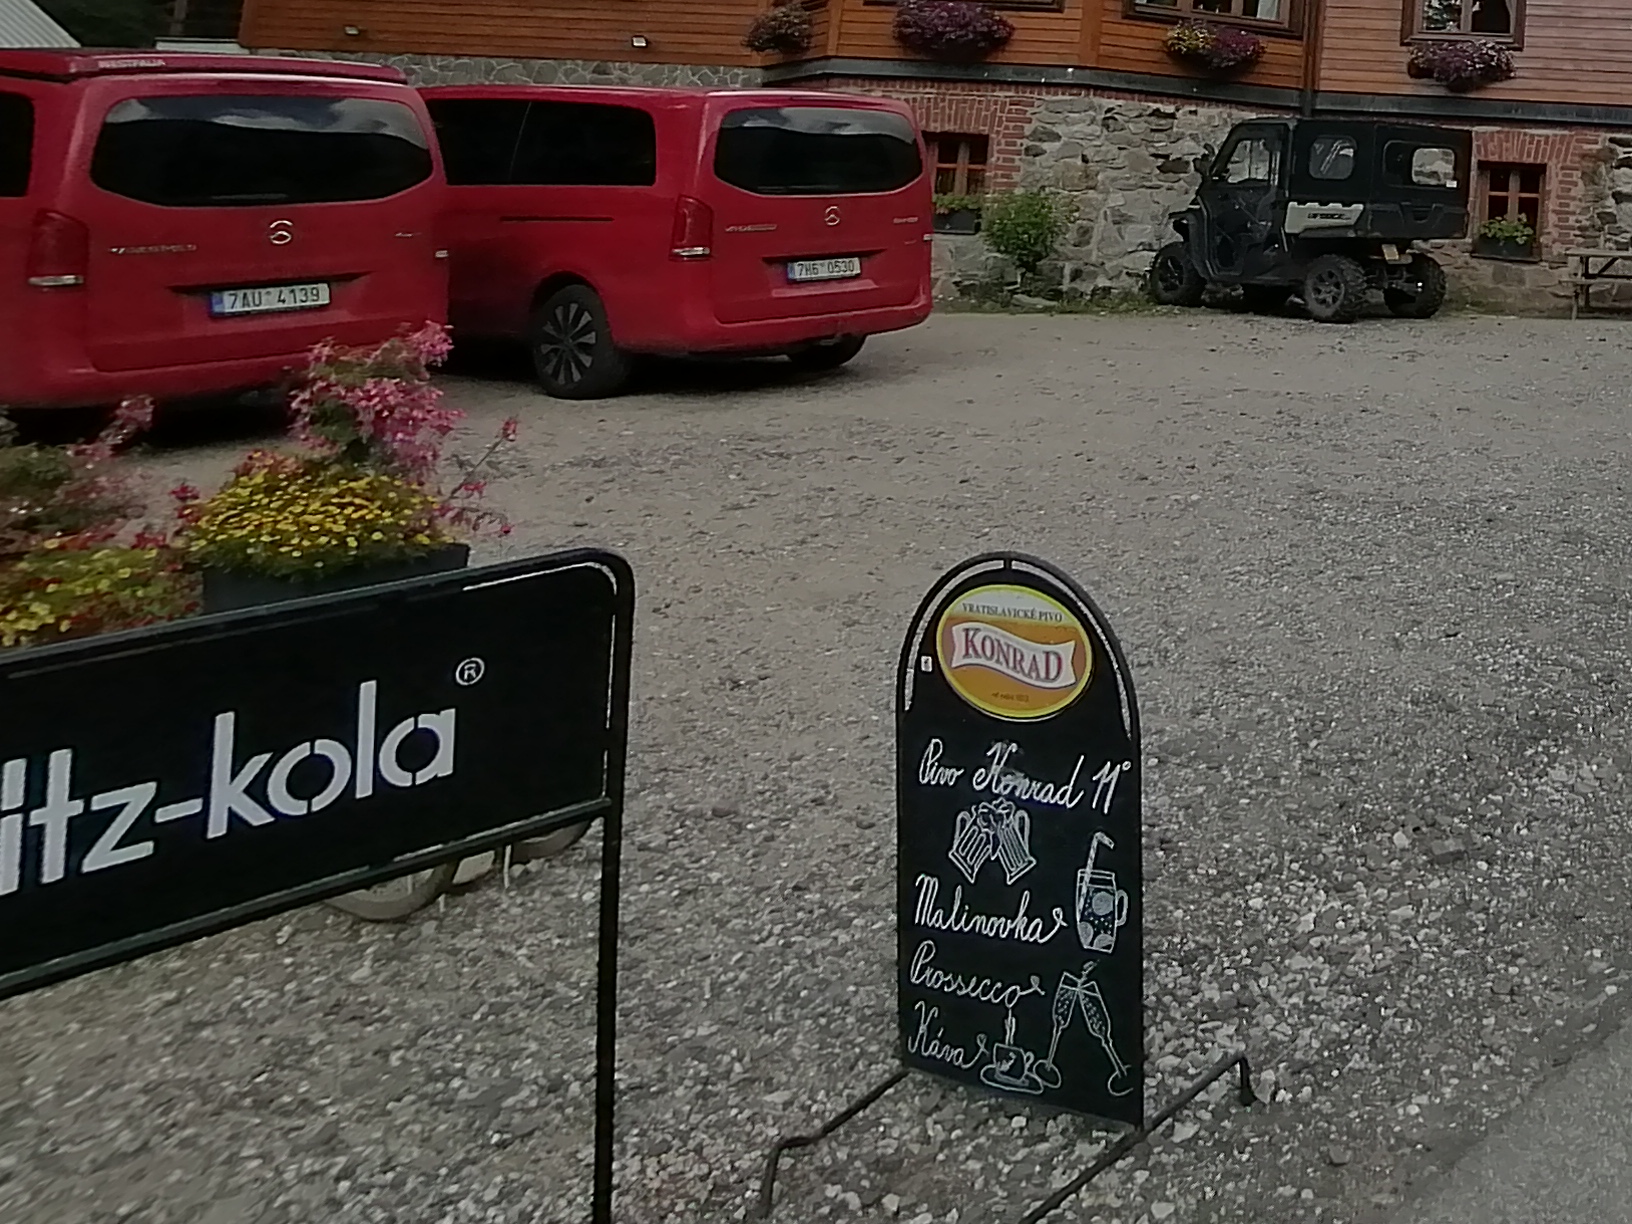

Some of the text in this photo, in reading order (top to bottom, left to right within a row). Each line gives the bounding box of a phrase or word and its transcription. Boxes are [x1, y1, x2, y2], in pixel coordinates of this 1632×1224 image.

[228, 287, 320, 310] 7AU 4139
[962, 602, 1063, 623] VRATISLAVICKÉ PIVO
[962, 627, 1062, 683] KONRAD
[919, 738, 965, 786] Pivo
[972, 741, 1085, 809] Konrad
[915, 873, 1068, 944] Malinovka
[908, 1001, 989, 1069] Káva
